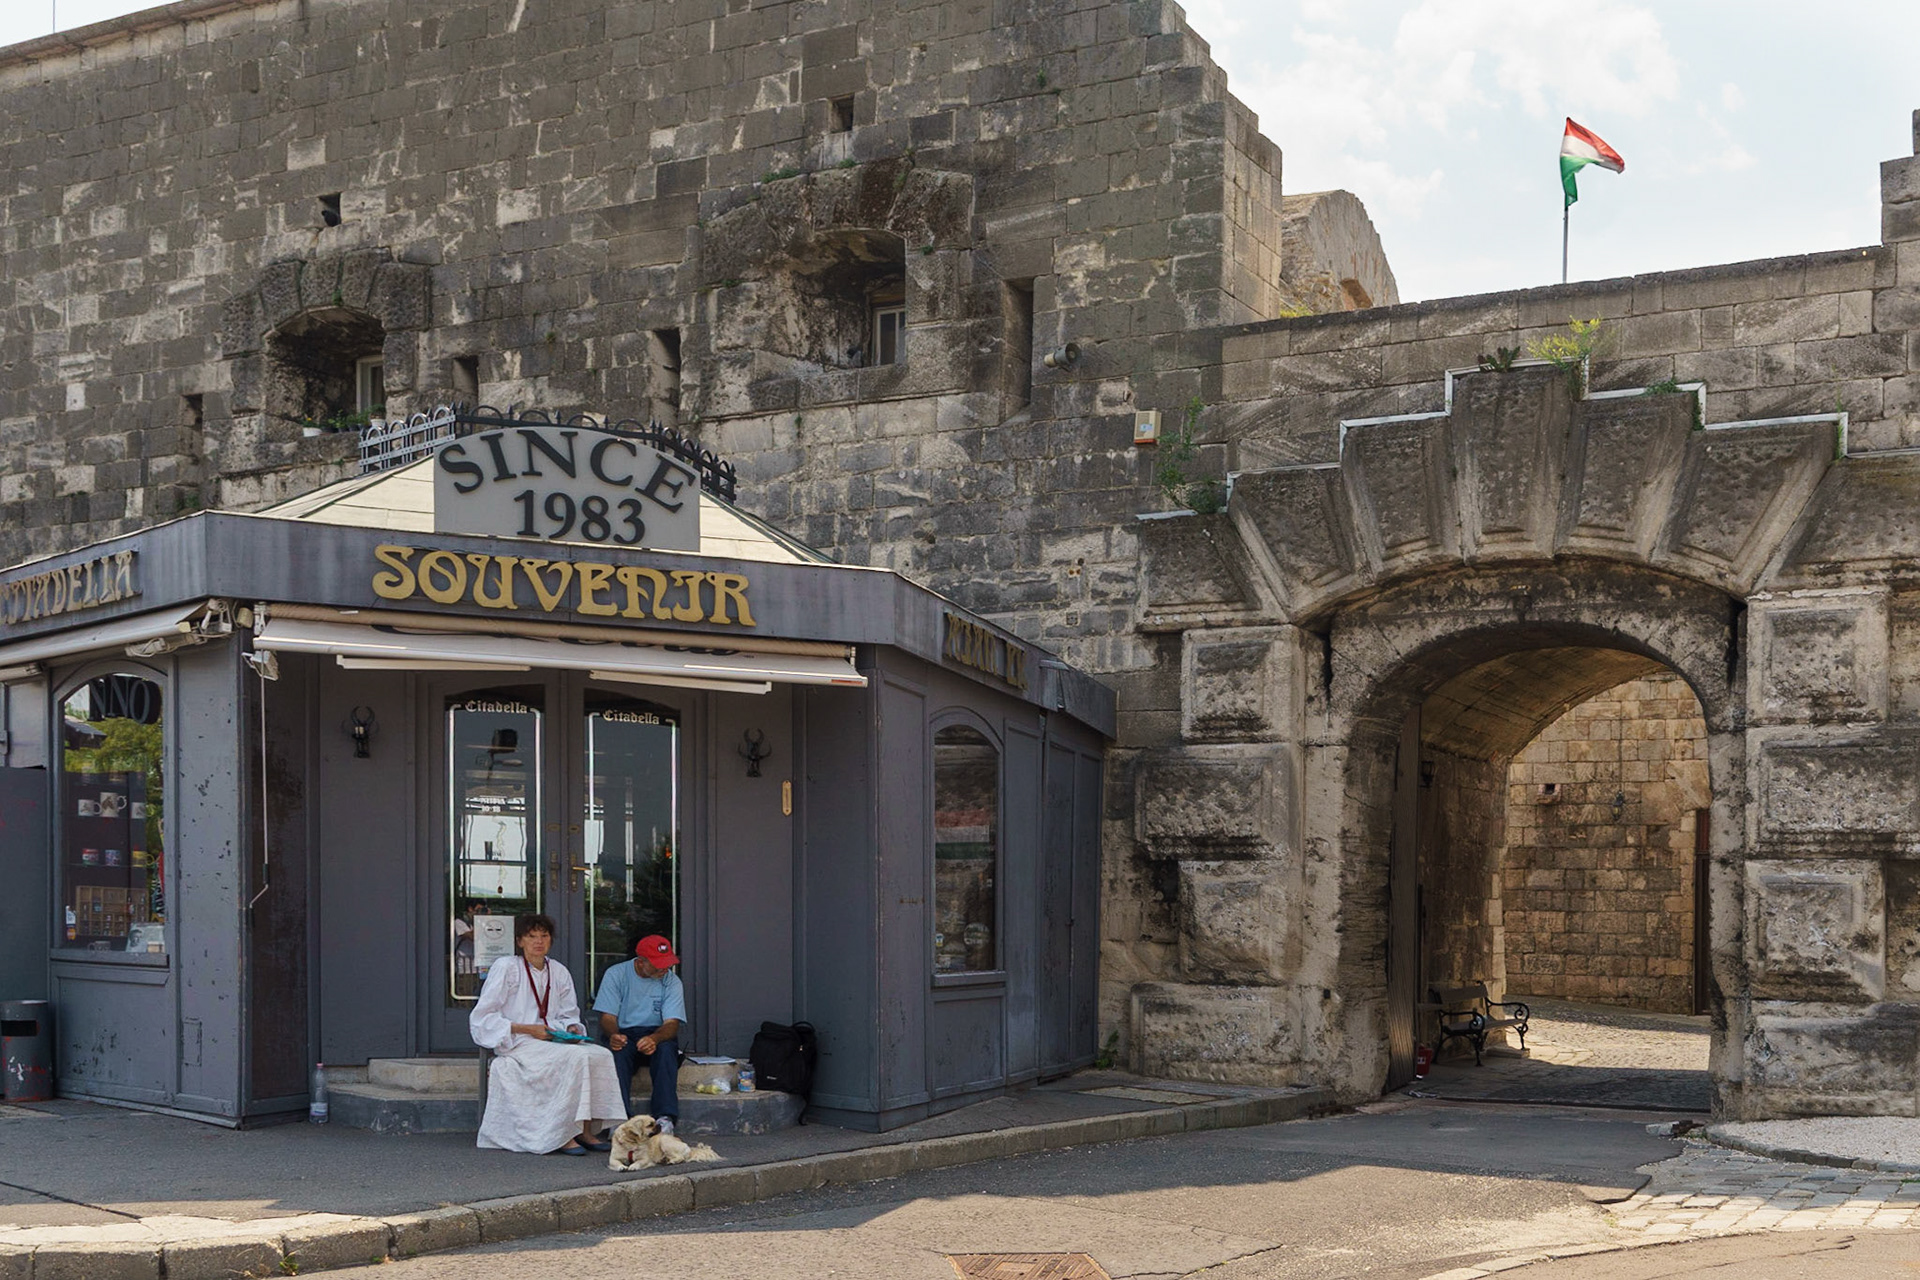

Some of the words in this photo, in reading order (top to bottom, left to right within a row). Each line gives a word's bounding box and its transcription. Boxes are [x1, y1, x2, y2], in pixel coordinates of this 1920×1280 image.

[439, 430, 696, 513] SINCE
[513, 489, 645, 544] 1983
[372, 544, 757, 627] SOUVENIR
[465, 700, 528, 714] Citadella
[603, 709, 660, 725] Citadella
